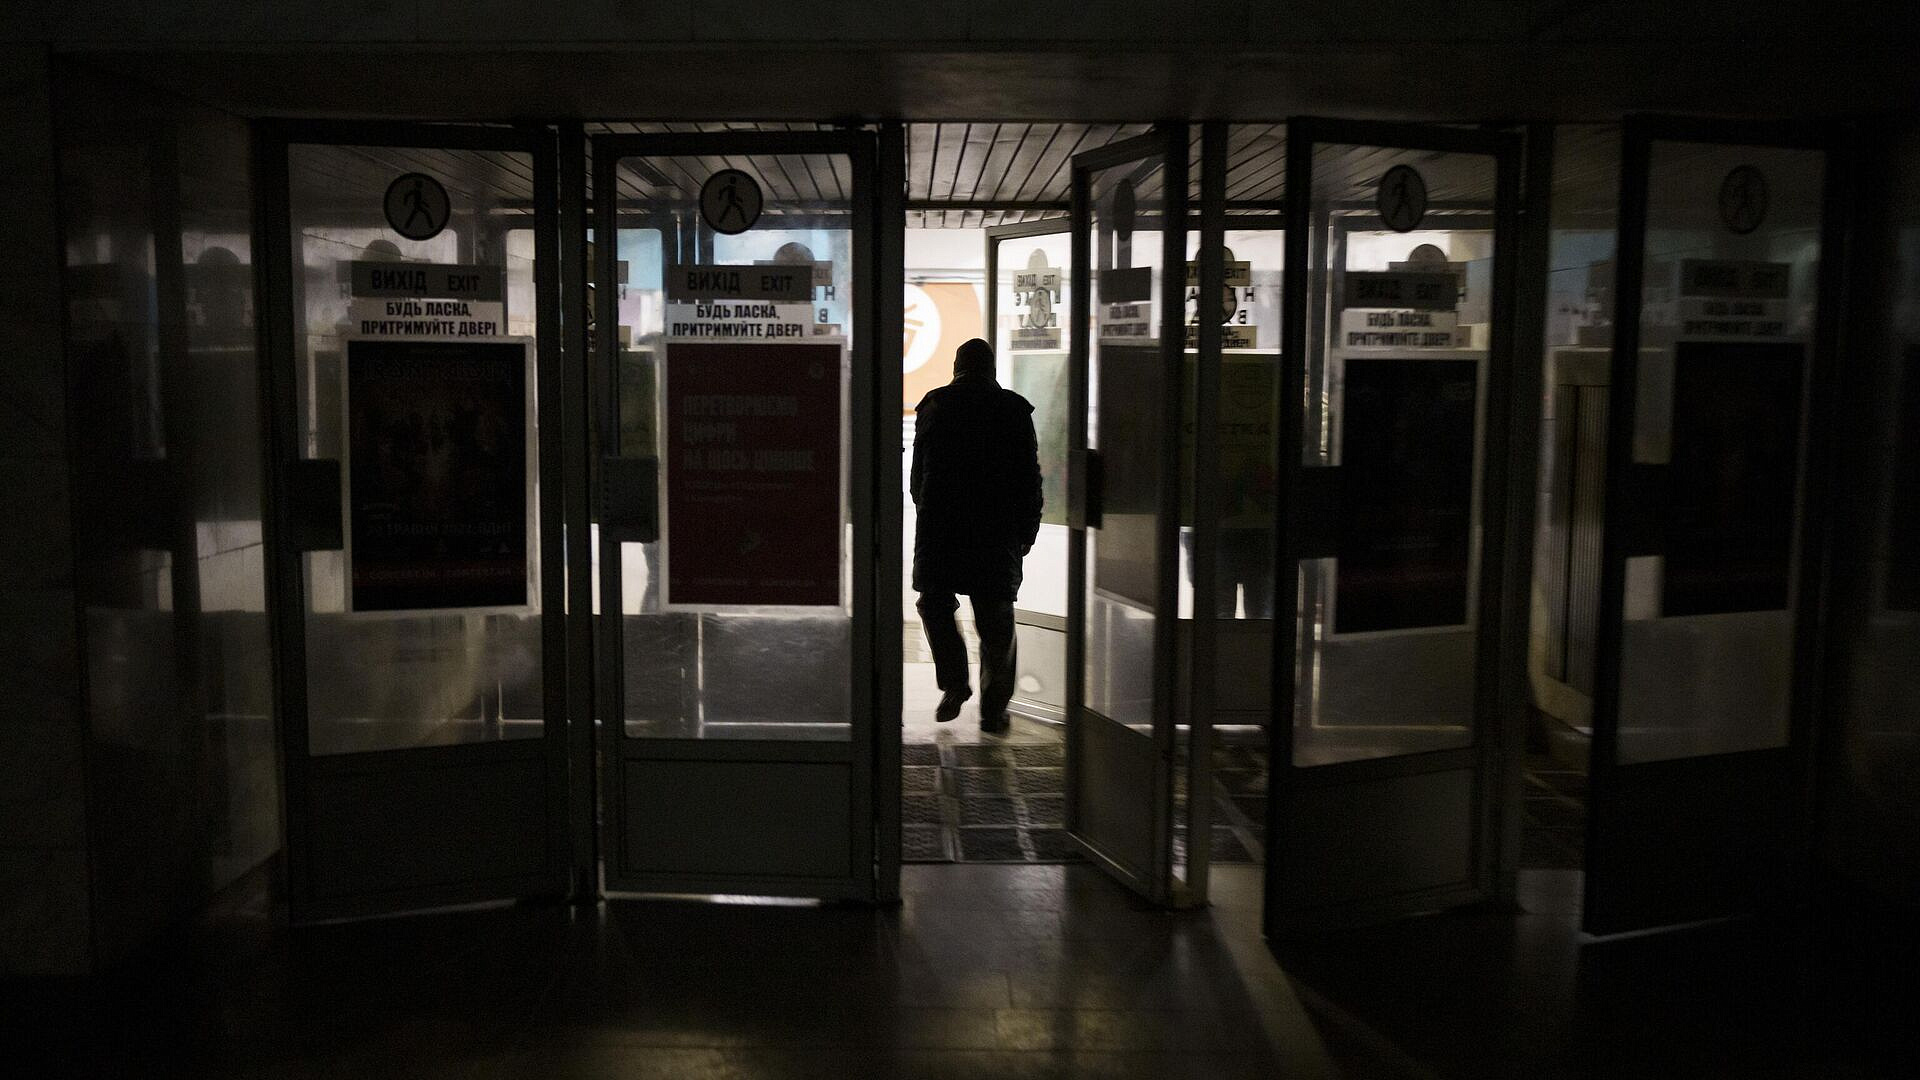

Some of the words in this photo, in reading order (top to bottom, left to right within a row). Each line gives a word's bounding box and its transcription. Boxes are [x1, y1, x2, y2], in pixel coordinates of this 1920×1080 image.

[371, 269, 427, 292] ВИХІД
[448, 274, 480, 291] EXIT
[687, 271, 741, 293] ВИХІД
[761, 275, 793, 292] EXIT
[386, 302, 422, 317] БУДЬ
[425, 303, 472, 318] ЛАСКА,
[696, 304, 731, 320] БУДЬ
[734, 305, 780, 319] ЛАСКА,
[361, 320, 455, 336] ПРИТРИМУЙТЕ
[458, 322, 497, 337] ДВЕРІ
[673, 321, 763, 338] ПРИТРИМУЙТЕ
[766, 323, 804, 339] ДВЕРІ
